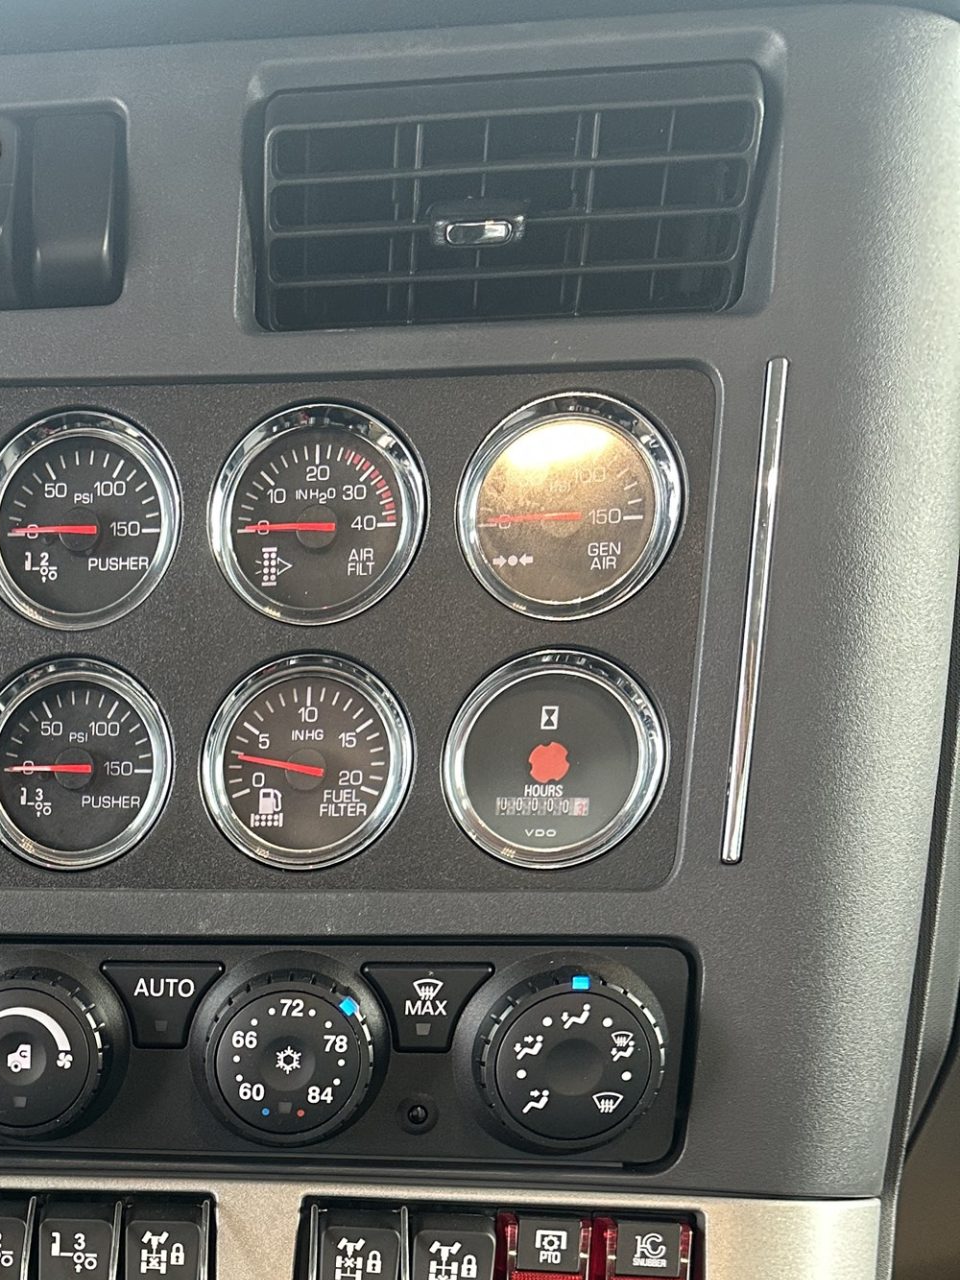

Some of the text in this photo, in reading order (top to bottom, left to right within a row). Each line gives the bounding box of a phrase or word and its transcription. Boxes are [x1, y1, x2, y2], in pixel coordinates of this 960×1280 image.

[306, 465, 330, 482] 20
[45, 483, 67, 498] 50
[93, 481, 126, 496] 100
[267, 488, 287, 504] 10
[342, 485, 367, 500] 30
[74, 493, 93, 504] PSI
[351, 515, 377, 531] 40
[589, 508, 622, 525] 150
[110, 521, 140, 537] 150
[349, 549, 374, 561] AIR
[587, 542, 621, 556] GEN
[88, 557, 149, 571] PUSHER
[347, 562, 375, 576] FILT
[590, 557, 617, 570] AIR
[298, 707, 318, 722] 10
[40, 722, 63, 736] 50
[89, 721, 120, 736] 100
[69, 732, 88, 743] PSI
[258, 734, 270, 749] 5
[339, 732, 357, 748] 15
[104, 761, 133, 776] 150
[252, 772, 265, 787] 0
[339, 770, 363, 786] 20
[323, 790, 360, 803] FUEL
[524, 784, 563, 797] HOURS
[82, 796, 140, 809] PUSHER
[320, 803, 367, 817] FILTER
[525, 829, 556, 837] VDO
[134, 978, 195, 998] AUTO
[280, 999, 304, 1018] 72
[405, 1000, 447, 1016] MAX
[232, 1031, 257, 1049] 66
[323, 1035, 348, 1052] 78
[239, 1083, 265, 1101] 60
[307, 1086, 333, 1104] 84
[540, 1251, 561, 1264] PTO
